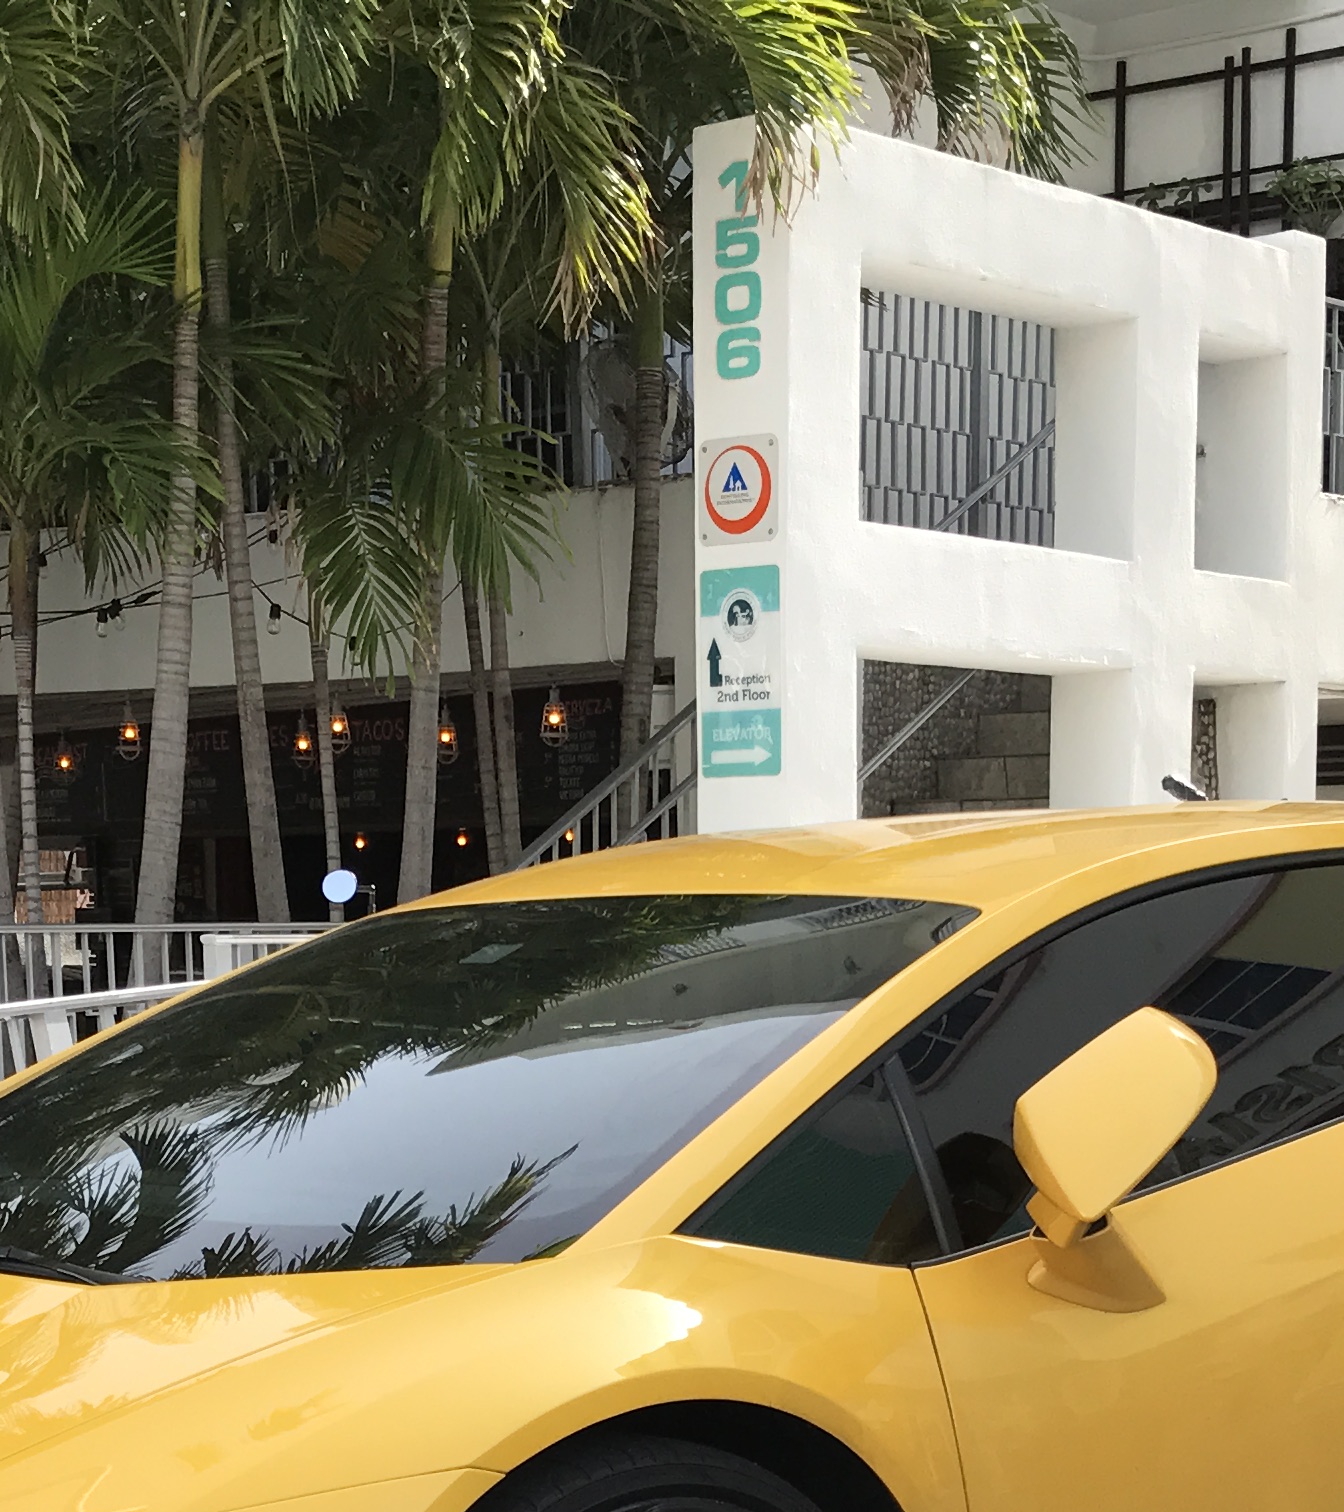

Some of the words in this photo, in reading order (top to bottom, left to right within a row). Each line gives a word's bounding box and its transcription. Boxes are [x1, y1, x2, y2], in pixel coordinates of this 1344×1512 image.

[714, 159, 762, 381] 1506
[724, 674, 771, 687] Reception
[717, 690, 739, 703] 2nd
[742, 688, 771, 701] Floor
[351, 718, 405, 743] TACOS
[712, 725, 772, 742] ELEVATOR
[187, 729, 230, 753] OFFEE
